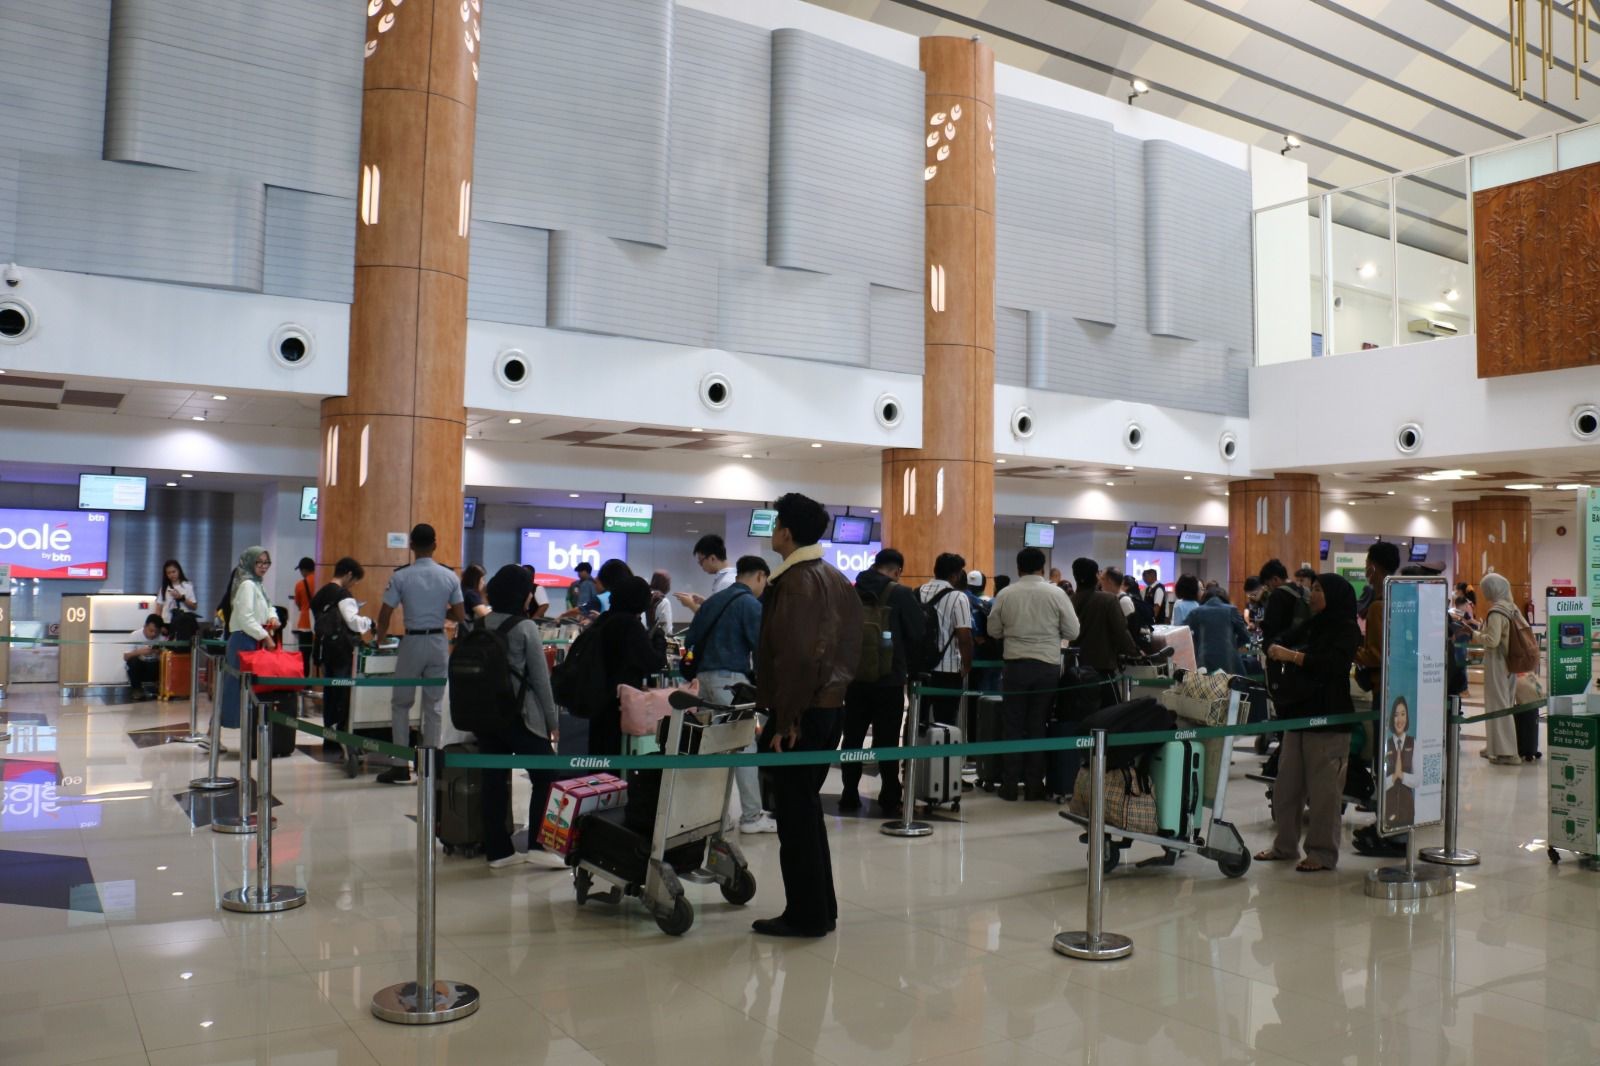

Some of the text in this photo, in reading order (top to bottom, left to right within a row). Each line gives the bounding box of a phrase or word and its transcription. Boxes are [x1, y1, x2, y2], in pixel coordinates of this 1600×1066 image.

[614, 505, 644, 514] Citilink
[88, 513, 105, 522] btn
[52, 552, 71, 562] btn
[548, 540, 600, 570] btn
[1556, 600, 1584, 612] Citilink
[66, 607, 86, 622] 09
[1560, 656, 1582, 664] BAGGAGE
[1567, 721, 1584, 729] Your
[1174, 730, 1197, 740] Citilink
[1553, 728, 1589, 738] Cabin Bag
[1574, 738, 1589, 746] Fly?
[840, 751, 876, 761] Citilink
[569, 757, 611, 768] Citilink
